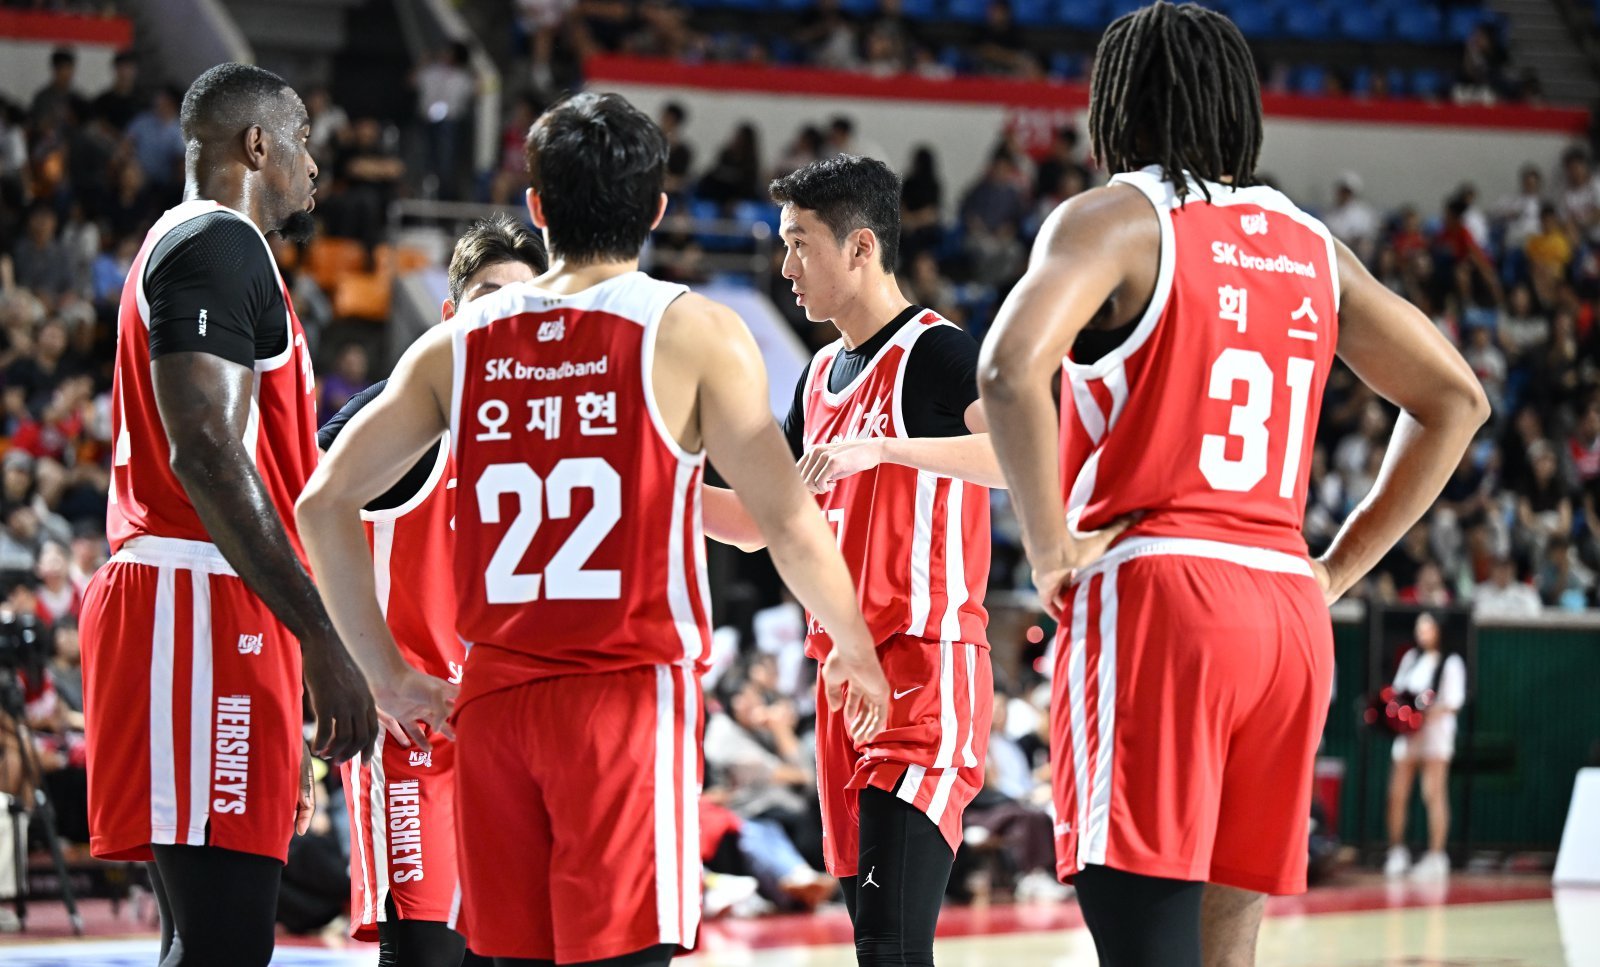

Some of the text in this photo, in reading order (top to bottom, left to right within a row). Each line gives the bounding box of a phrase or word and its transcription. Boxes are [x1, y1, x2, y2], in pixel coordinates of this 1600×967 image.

[1211, 240, 1316, 279] SK broadband
[484, 354, 608, 382] SK broadband
[1198, 347, 1315, 499] 31
[475, 457, 622, 604] 22
[213, 696, 251, 815] HERSHEY'S
[389, 782, 424, 884] HERSHEY'S
